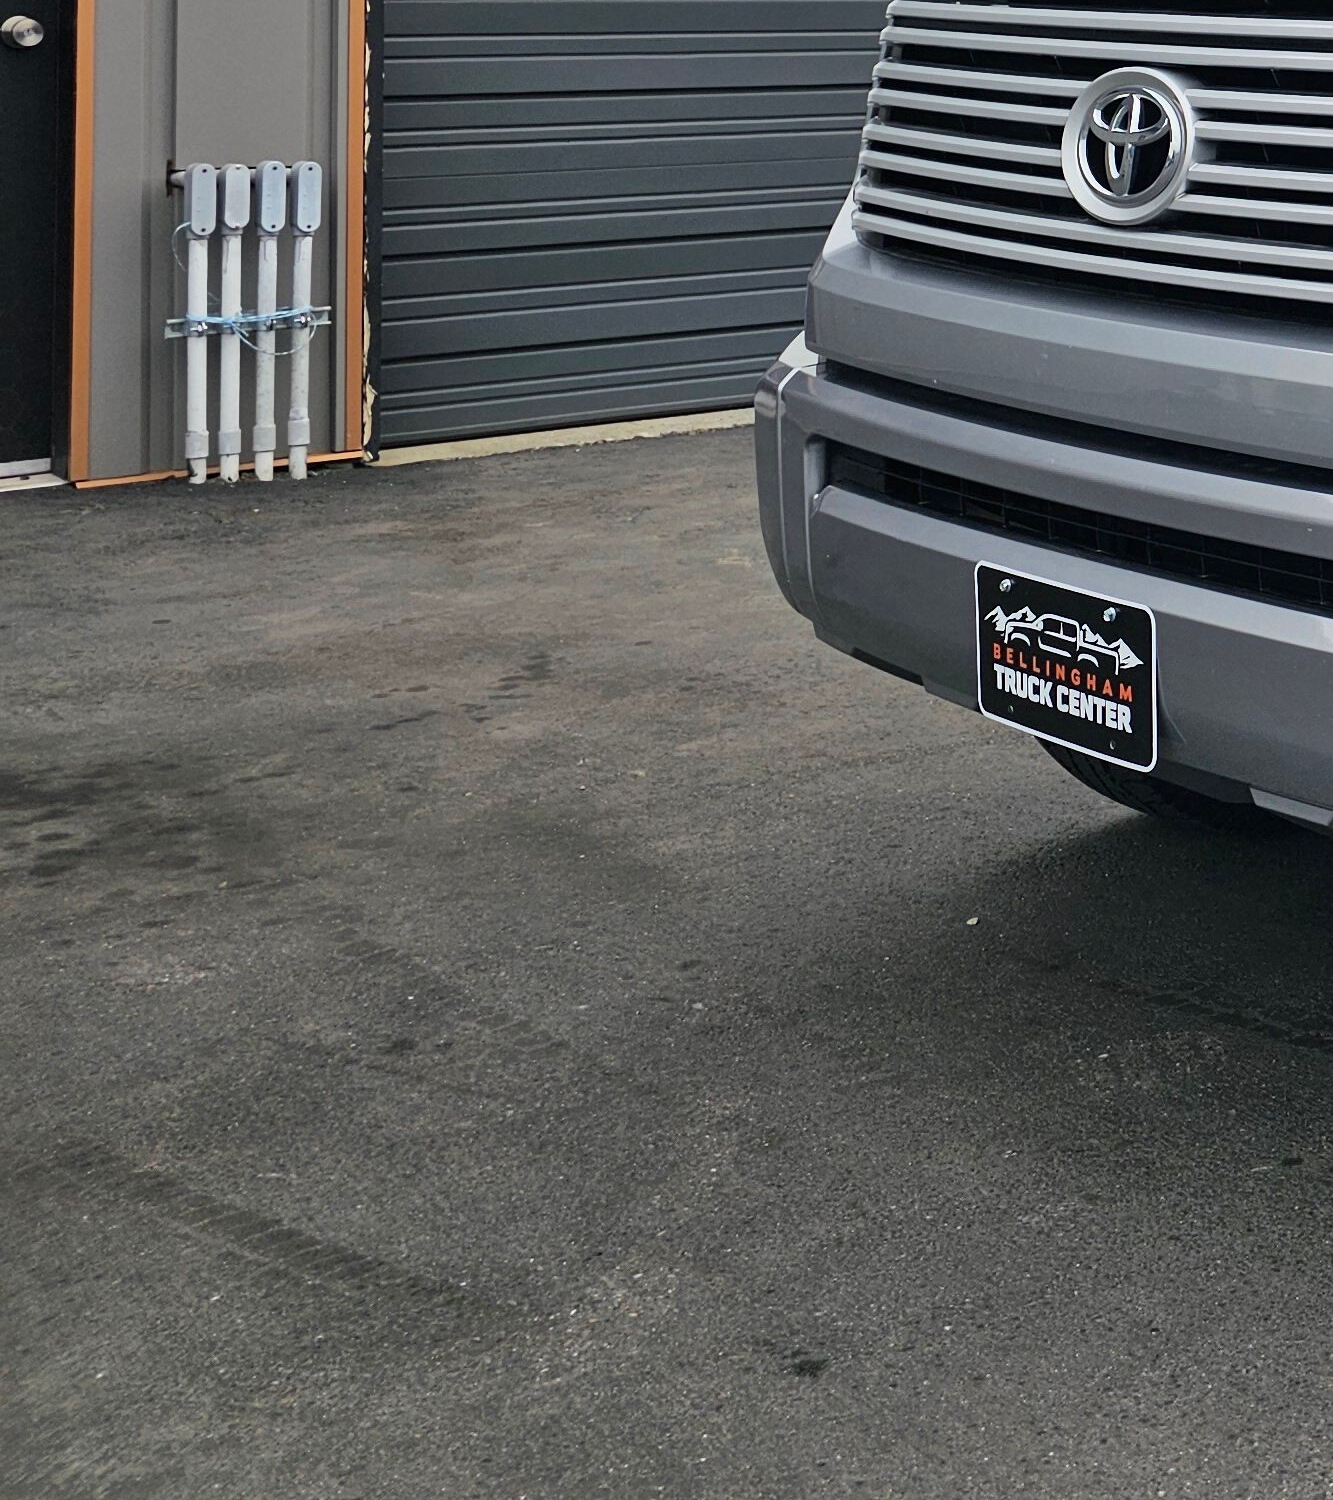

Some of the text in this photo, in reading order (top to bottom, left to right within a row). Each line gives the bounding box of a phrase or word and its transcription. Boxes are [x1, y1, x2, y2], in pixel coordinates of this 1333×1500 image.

[992, 642, 1134, 703] BELLINGHAM
[993, 663, 1133, 734] TRUCK CENTER
